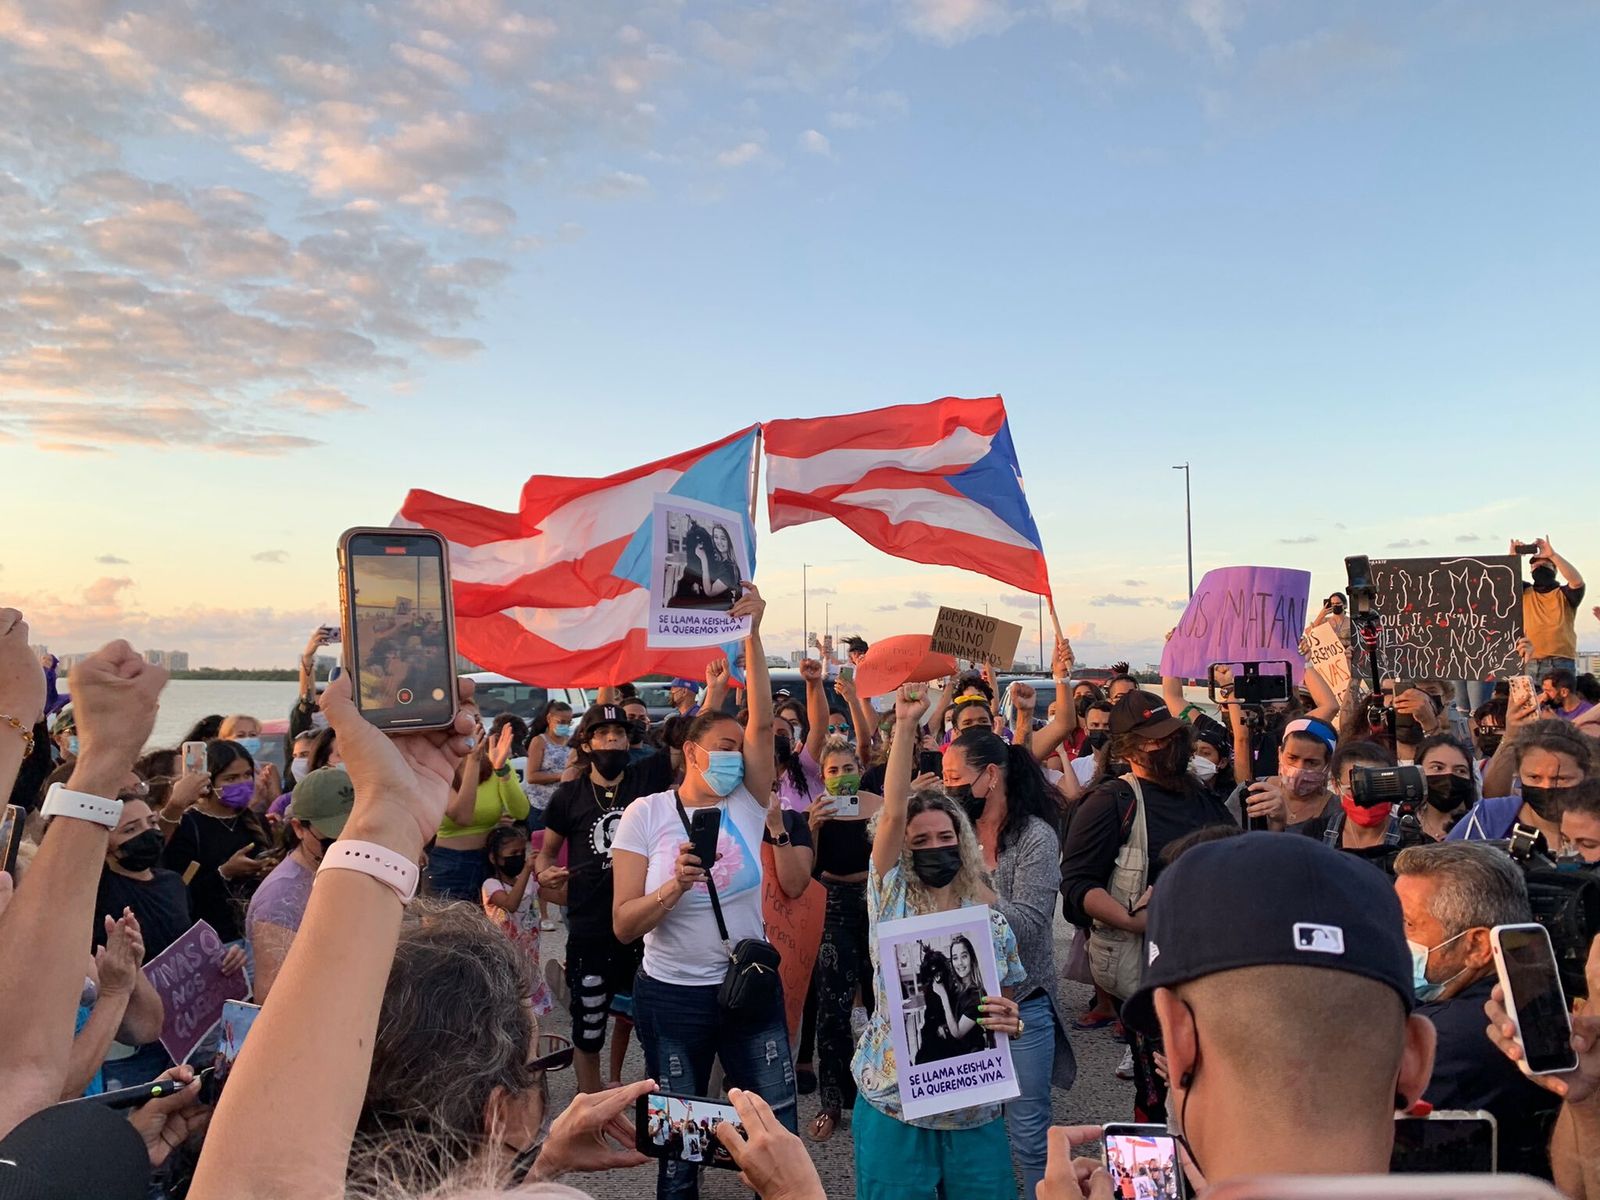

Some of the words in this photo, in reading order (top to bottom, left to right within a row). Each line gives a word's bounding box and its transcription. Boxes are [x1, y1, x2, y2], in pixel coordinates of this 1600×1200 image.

[659, 614, 668, 624] SE
[671, 615, 700, 625] LLAMA
[702, 616, 737, 626] KEISHLA
[659, 625, 670, 633] LA
[672, 625, 718, 635] QUEREMOS
[1218, 589, 1304, 649] MATAN
[1380, 614, 1402, 627] QUE
[1410, 612, 1421, 627] SE
[935, 623, 983, 647] ASESINO
[1450, 627, 1500, 660] NOS
[1311, 640, 1344, 665] EREMOS
[1394, 646, 1490, 680] BUSCAN
[1318, 659, 1351, 687] VAS
[171, 972, 207, 1010] NOS
[909, 1074, 920, 1086] SE
[922, 1066, 956, 1083] LLAMA
[956, 1059, 994, 1075] KEISHLA
[995, 1056, 1002, 1067] Y
[911, 1087, 925, 1099] LA
[926, 1075, 978, 1096] QUEREMOS
[979, 1069, 1006, 1083] VIVA.
